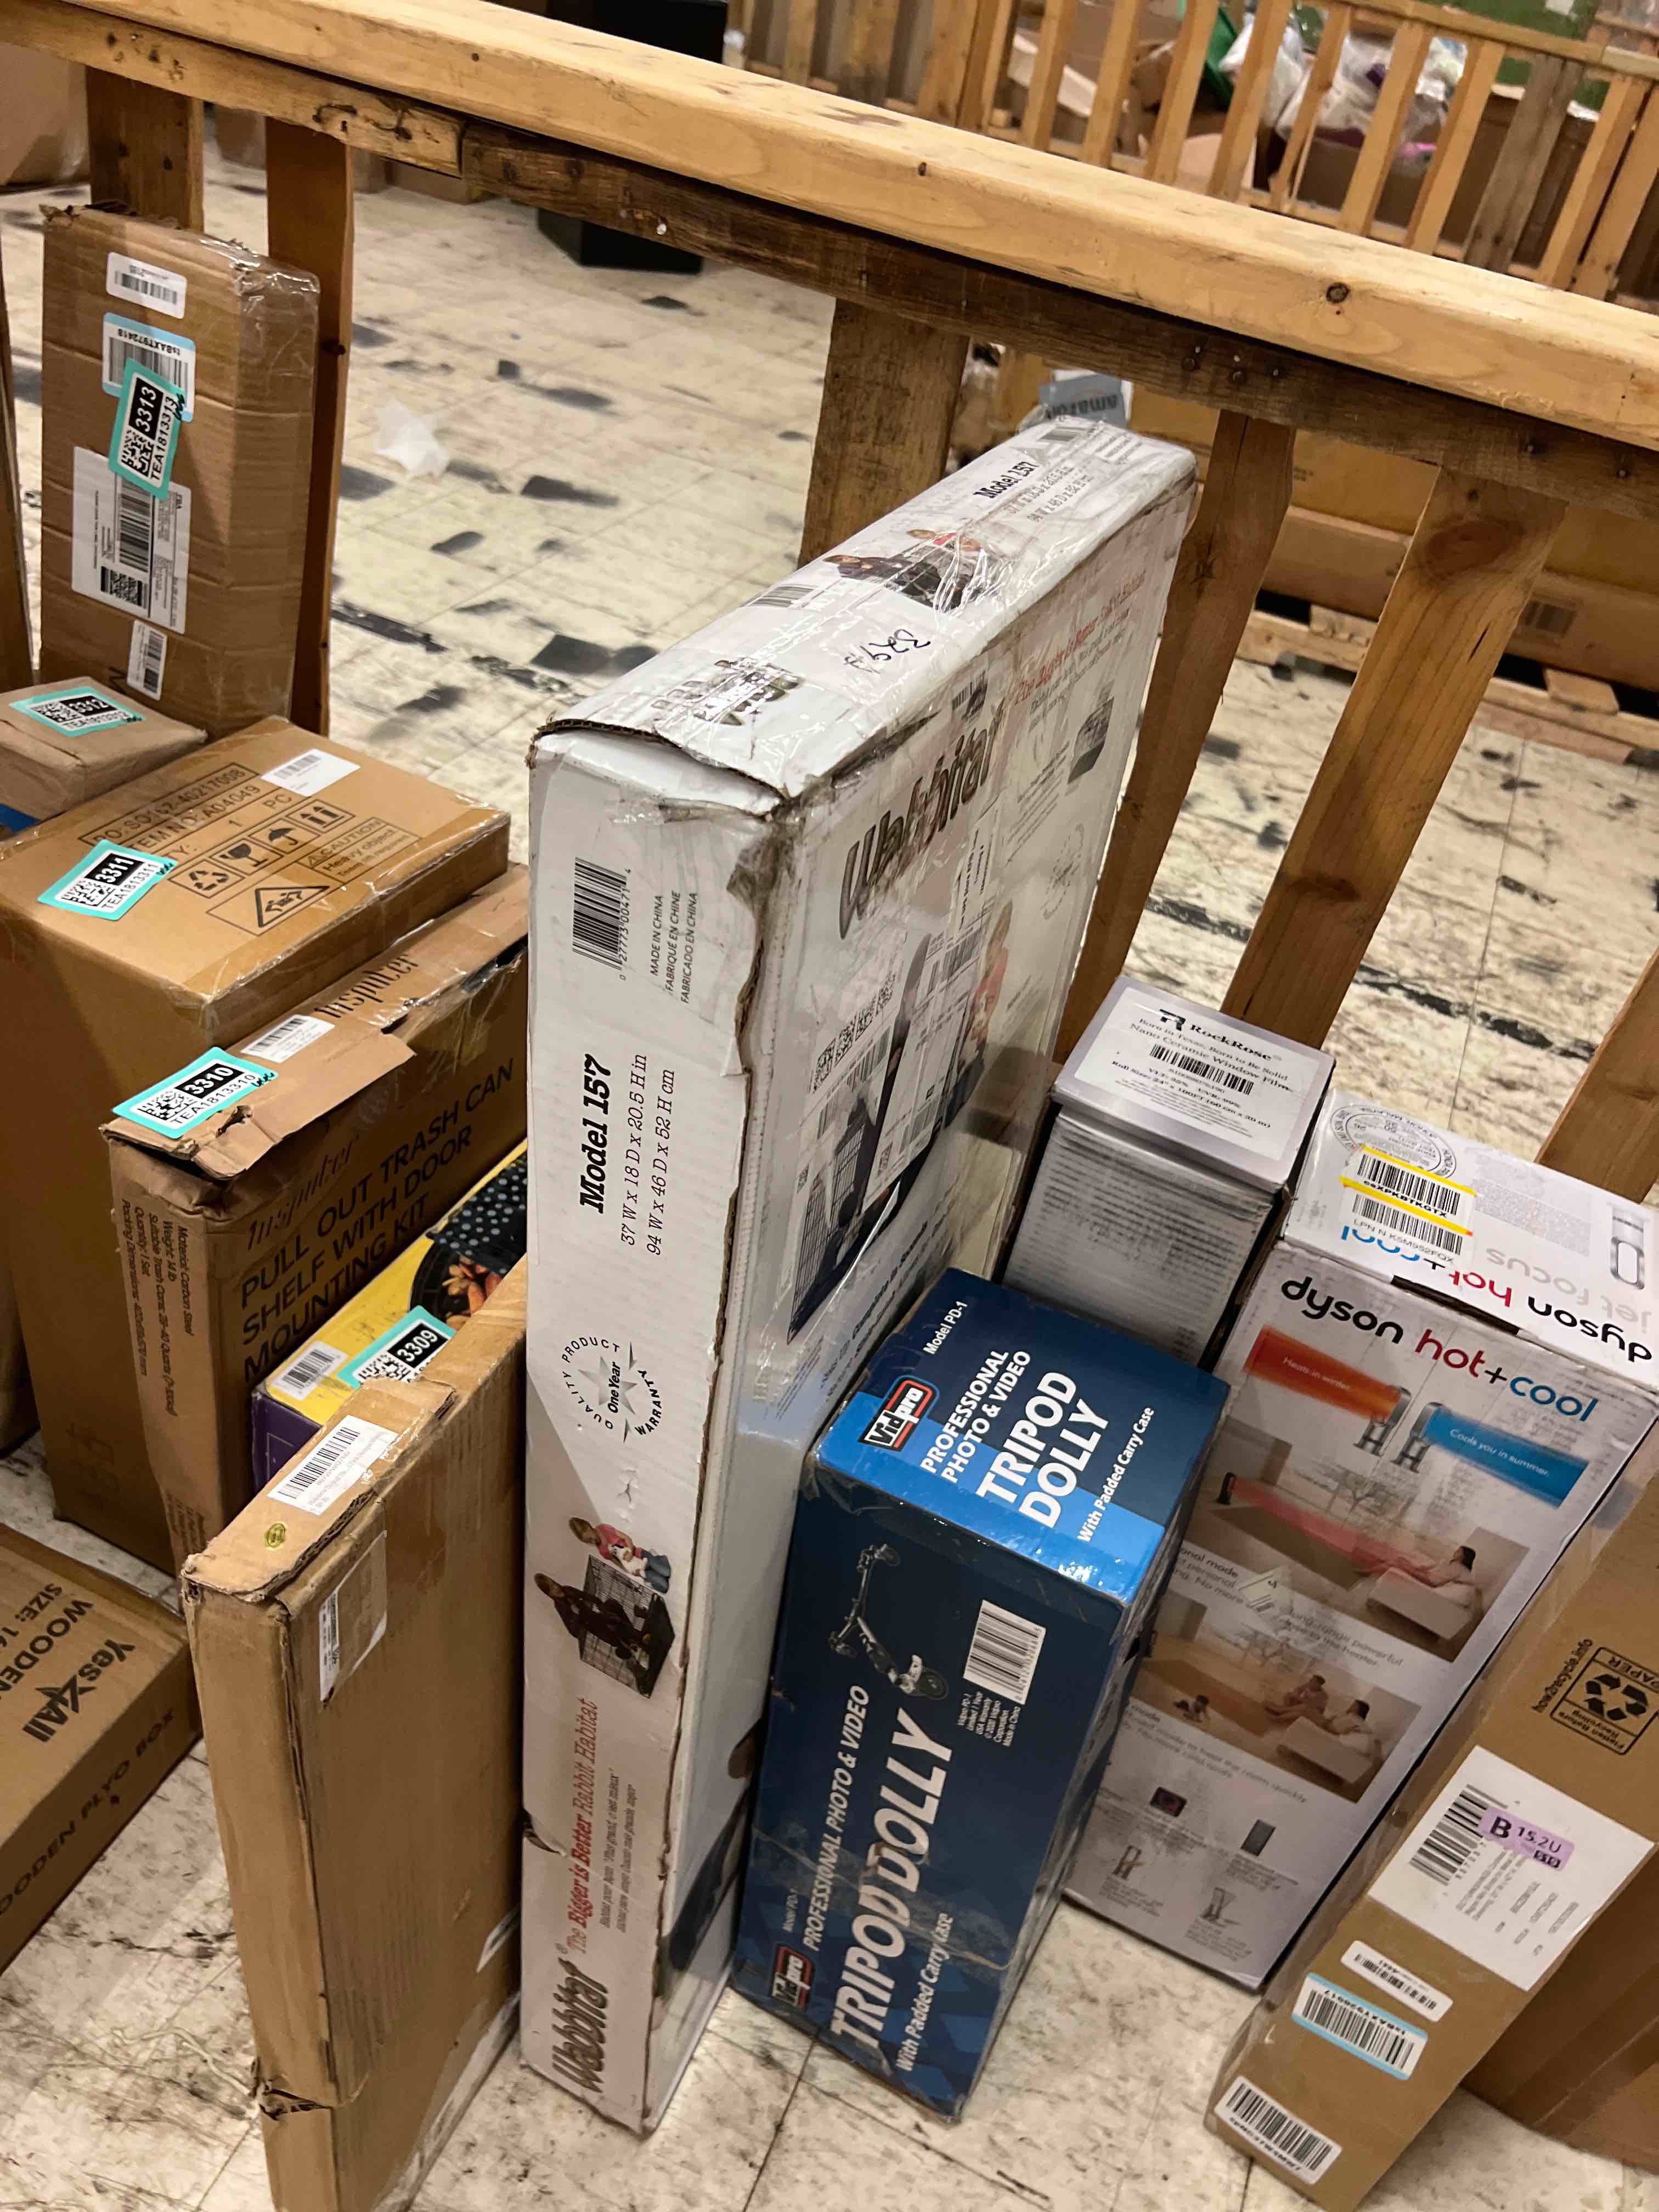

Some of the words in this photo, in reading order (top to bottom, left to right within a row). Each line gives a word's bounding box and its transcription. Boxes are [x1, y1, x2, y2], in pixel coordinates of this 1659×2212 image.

[135, 386, 157, 433] 3313
[150, 396, 177, 481] TEA1813313
[68, 698, 109, 713] 3312
[228, 819, 242, 828] 1
[263, 793, 292, 810] PC
[320, 820, 383, 856] CAUTION
[94, 856, 136, 884] 3311
[101, 862, 159, 909] TEA1813311
[653, 894, 663, 929] CHINA
[670, 890, 681, 925] CHINE
[686, 892, 698, 929] CHINA
[670, 925, 679, 939] EN
[685, 929, 695, 945] EN
[650, 940, 661, 977] MADE
[680, 945, 694, 1005] FABRICADO
[1130, 1023, 1160, 1040] Nano
[1162, 1033, 1210, 1059] Ceramic
[1212, 1056, 1261, 1080] Window
[1189, 1024, 1273, 1062] RockRose
[184, 1066, 235, 1096] 3310
[630, 1073, 646, 1090] H
[631, 1053, 647, 1073] in
[662, 1069, 675, 1095] cm
[170, 1073, 257, 1124] TEA1813310
[583, 1053, 612, 1115] 157
[627, 1091, 645, 1131] 20.5
[656, 1096, 673, 1115] H
[630, 1134, 642, 1148] x
[654, 1116, 671, 1140] 52
[580, 1117, 608, 1214] Model
[625, 1149, 641, 1165] D
[652, 1158, 668, 1174] D
[657, 1143, 669, 1157] x
[240, 1234, 311, 1310] PULL
[317, 1174, 374, 1238] OUT
[380, 1101, 460, 1184] TRASH
[464, 1057, 515, 1115] CAN
[624, 1165, 640, 1187] 18
[650, 1175, 667, 1197] 46
[622, 1204, 638, 1221] W
[626, 1190, 638, 1205] x
[652, 1199, 664, 1214] x
[241, 1252, 325, 1346] SHELF
[332, 1185, 402, 1261] WITH
[403, 1124, 474, 1200] DOOR
[620, 1223, 636, 1246] 37
[648, 1213, 664, 1231] W
[646, 1235, 662, 1256] 94
[244, 1233, 388, 1383] MOUNTING
[393, 1192, 432, 1248] KIT
[1485, 1246, 1590, 1306] focus
[396, 1328, 439, 1363] 3309
[923, 1322, 953, 1356] Model
[943, 1300, 969, 1325] PD-1
[1527, 1295, 1653, 1364] dyson
[561, 1336, 620, 1363] PRODUCT
[1280, 1276, 1404, 1344] dyson
[1414, 1328, 1599, 1423] hot+cool
[608, 1361, 622, 1390] Year
[991, 1350, 1032, 1403] VIDEO
[562, 1371, 614, 1430] QUALITY
[607, 1389, 620, 1414] One
[634, 1369, 663, 1435] WARRANTY
[864, 1386, 926, 1447] Vidpro
[918, 1349, 1010, 1475] PROFESSIONAL
[981, 1402, 1002, 1419] &
[940, 1417, 992, 1484] PHOTO
[974, 1371, 1079, 1505] TRIPOD
[1449, 1428, 1477, 1447] Cools
[1478, 1442, 1498, 1455] you
[1498, 1448, 1508, 1459] in
[1018, 1398, 1110, 1529] DOLLY
[1077, 1509, 1105, 1544] With
[1093, 1461, 1127, 1513] Padded
[1116, 1434, 1145, 1467] Carry
[1132, 1406, 1155, 1434] Case
[1207, 1559, 1239, 1578] mode
[14, 1582, 63, 1623] SIZE:
[574, 1697, 599, 1765] Habitat
[839, 1684, 871, 1752] VIDEO
[843, 1749, 859, 1769] &
[572, 1762, 596, 1818] Rabbit
[824, 1766, 854, 1834] PHOTO
[861, 1706, 954, 1894] DOLLY
[571, 1814, 594, 1869] Better
[1489, 1816, 1512, 1838] B
[567, 1877, 594, 1929] Bigger
[802, 1830, 843, 1954] PROFESSIONAL
[566, 1927, 588, 1954] The
[830, 1869, 912, 2051] TRIPOD
[919, 1938, 946, 1983] Carry
[907, 1975, 934, 2036] Padded
[551, 1957, 608, 2094] Wabbitat
[896, 2027, 920, 2073] With
